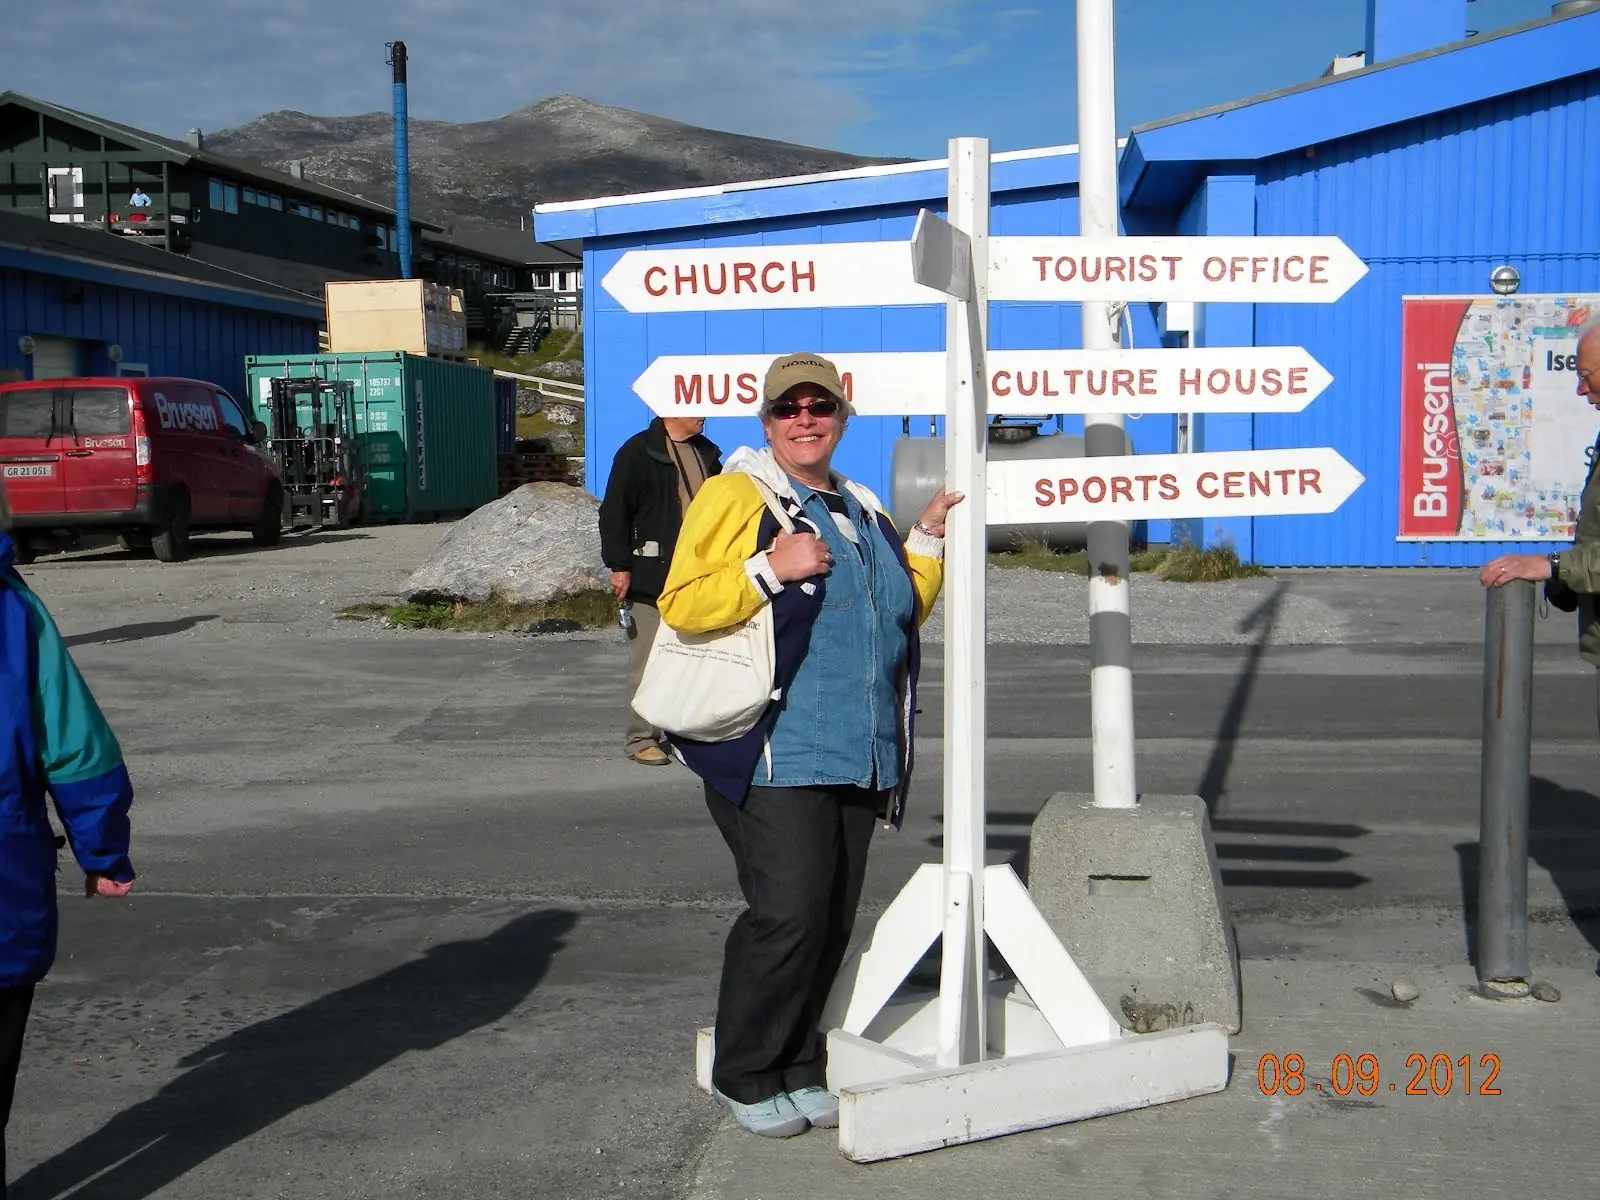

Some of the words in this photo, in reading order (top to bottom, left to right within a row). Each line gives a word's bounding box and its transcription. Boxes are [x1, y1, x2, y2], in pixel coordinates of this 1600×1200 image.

[644, 261, 815, 297] CHURCH
[1033, 253, 1182, 283] TOURIST
[1202, 255, 1330, 284] OFFICE
[781, 360, 825, 369] HONDA
[674, 372, 853, 405] MUS
[991, 368, 1157, 397] CULTURE
[1179, 367, 1309, 397] HOUSE
[7, 467, 19, 476] GR
[20, 467, 30, 475] 21
[1034, 473, 1180, 507] SPORTS
[1196, 468, 1322, 499] CENTR
